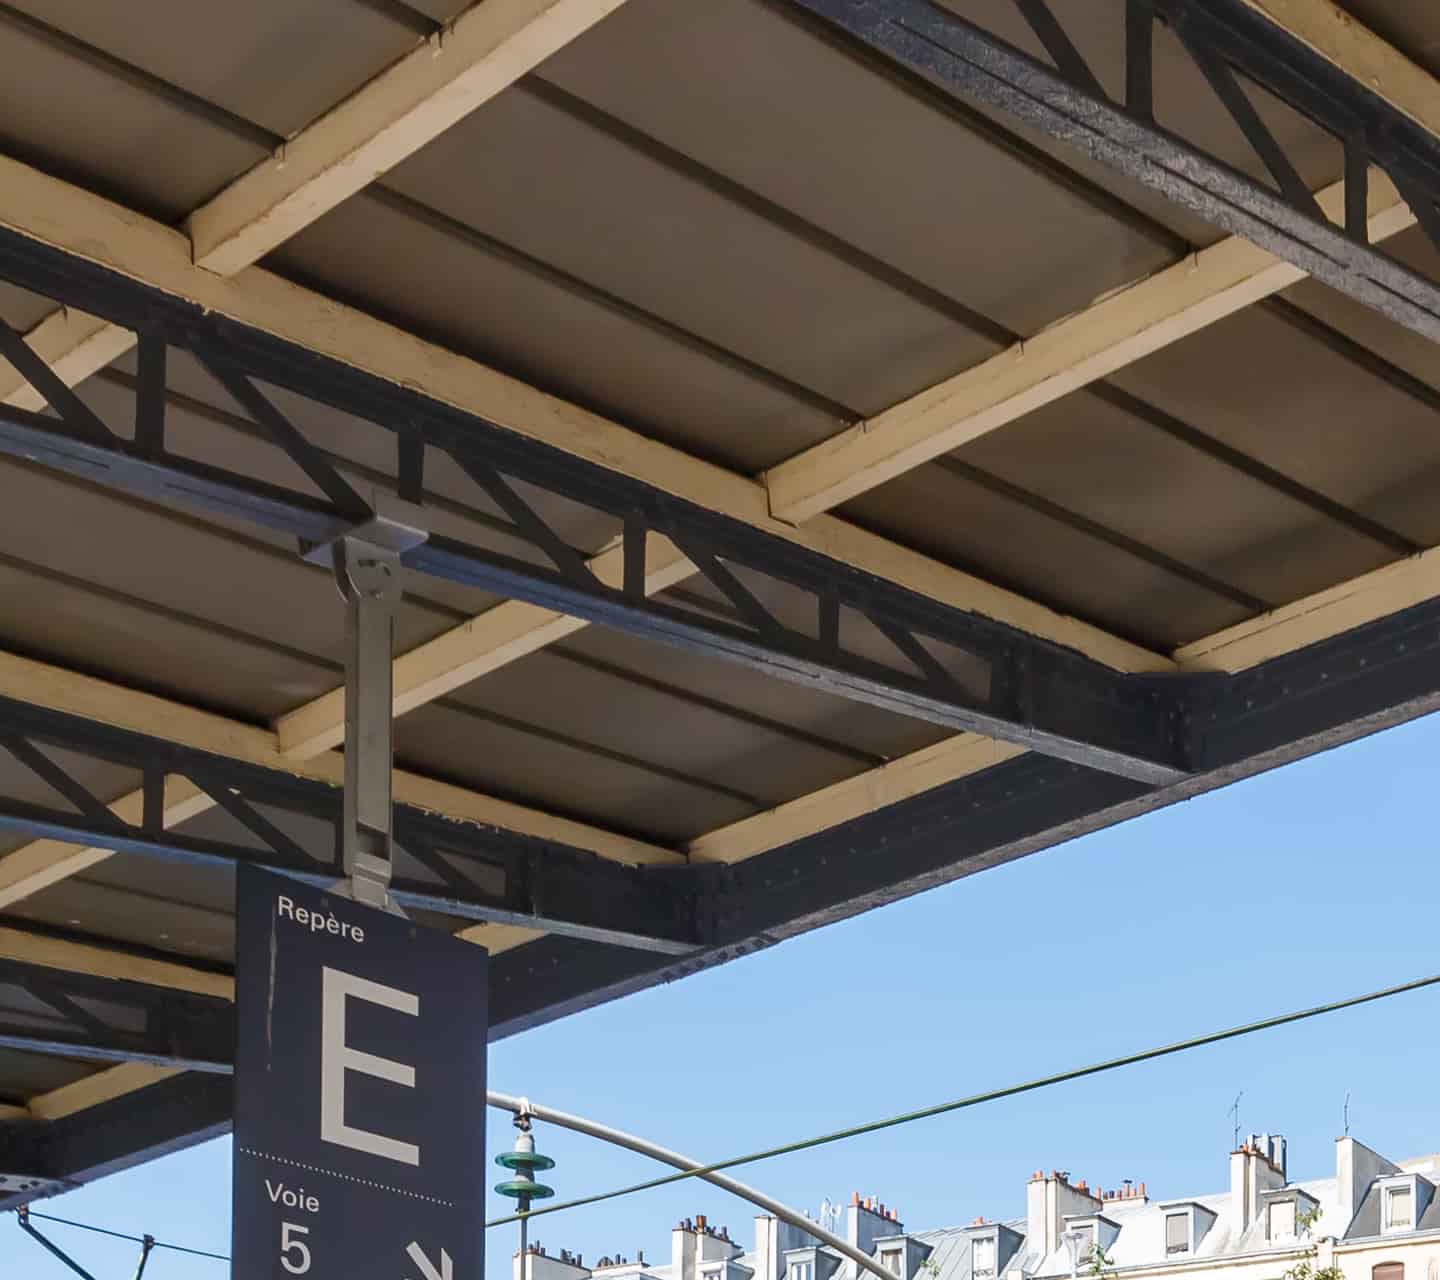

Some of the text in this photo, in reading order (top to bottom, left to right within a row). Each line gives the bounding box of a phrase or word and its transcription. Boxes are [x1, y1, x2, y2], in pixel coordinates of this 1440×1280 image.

[277, 895, 366, 944] Repère
[320, 965, 420, 1167] E
[265, 1178, 321, 1214] Voie
[279, 1221, 312, 1276] 5
